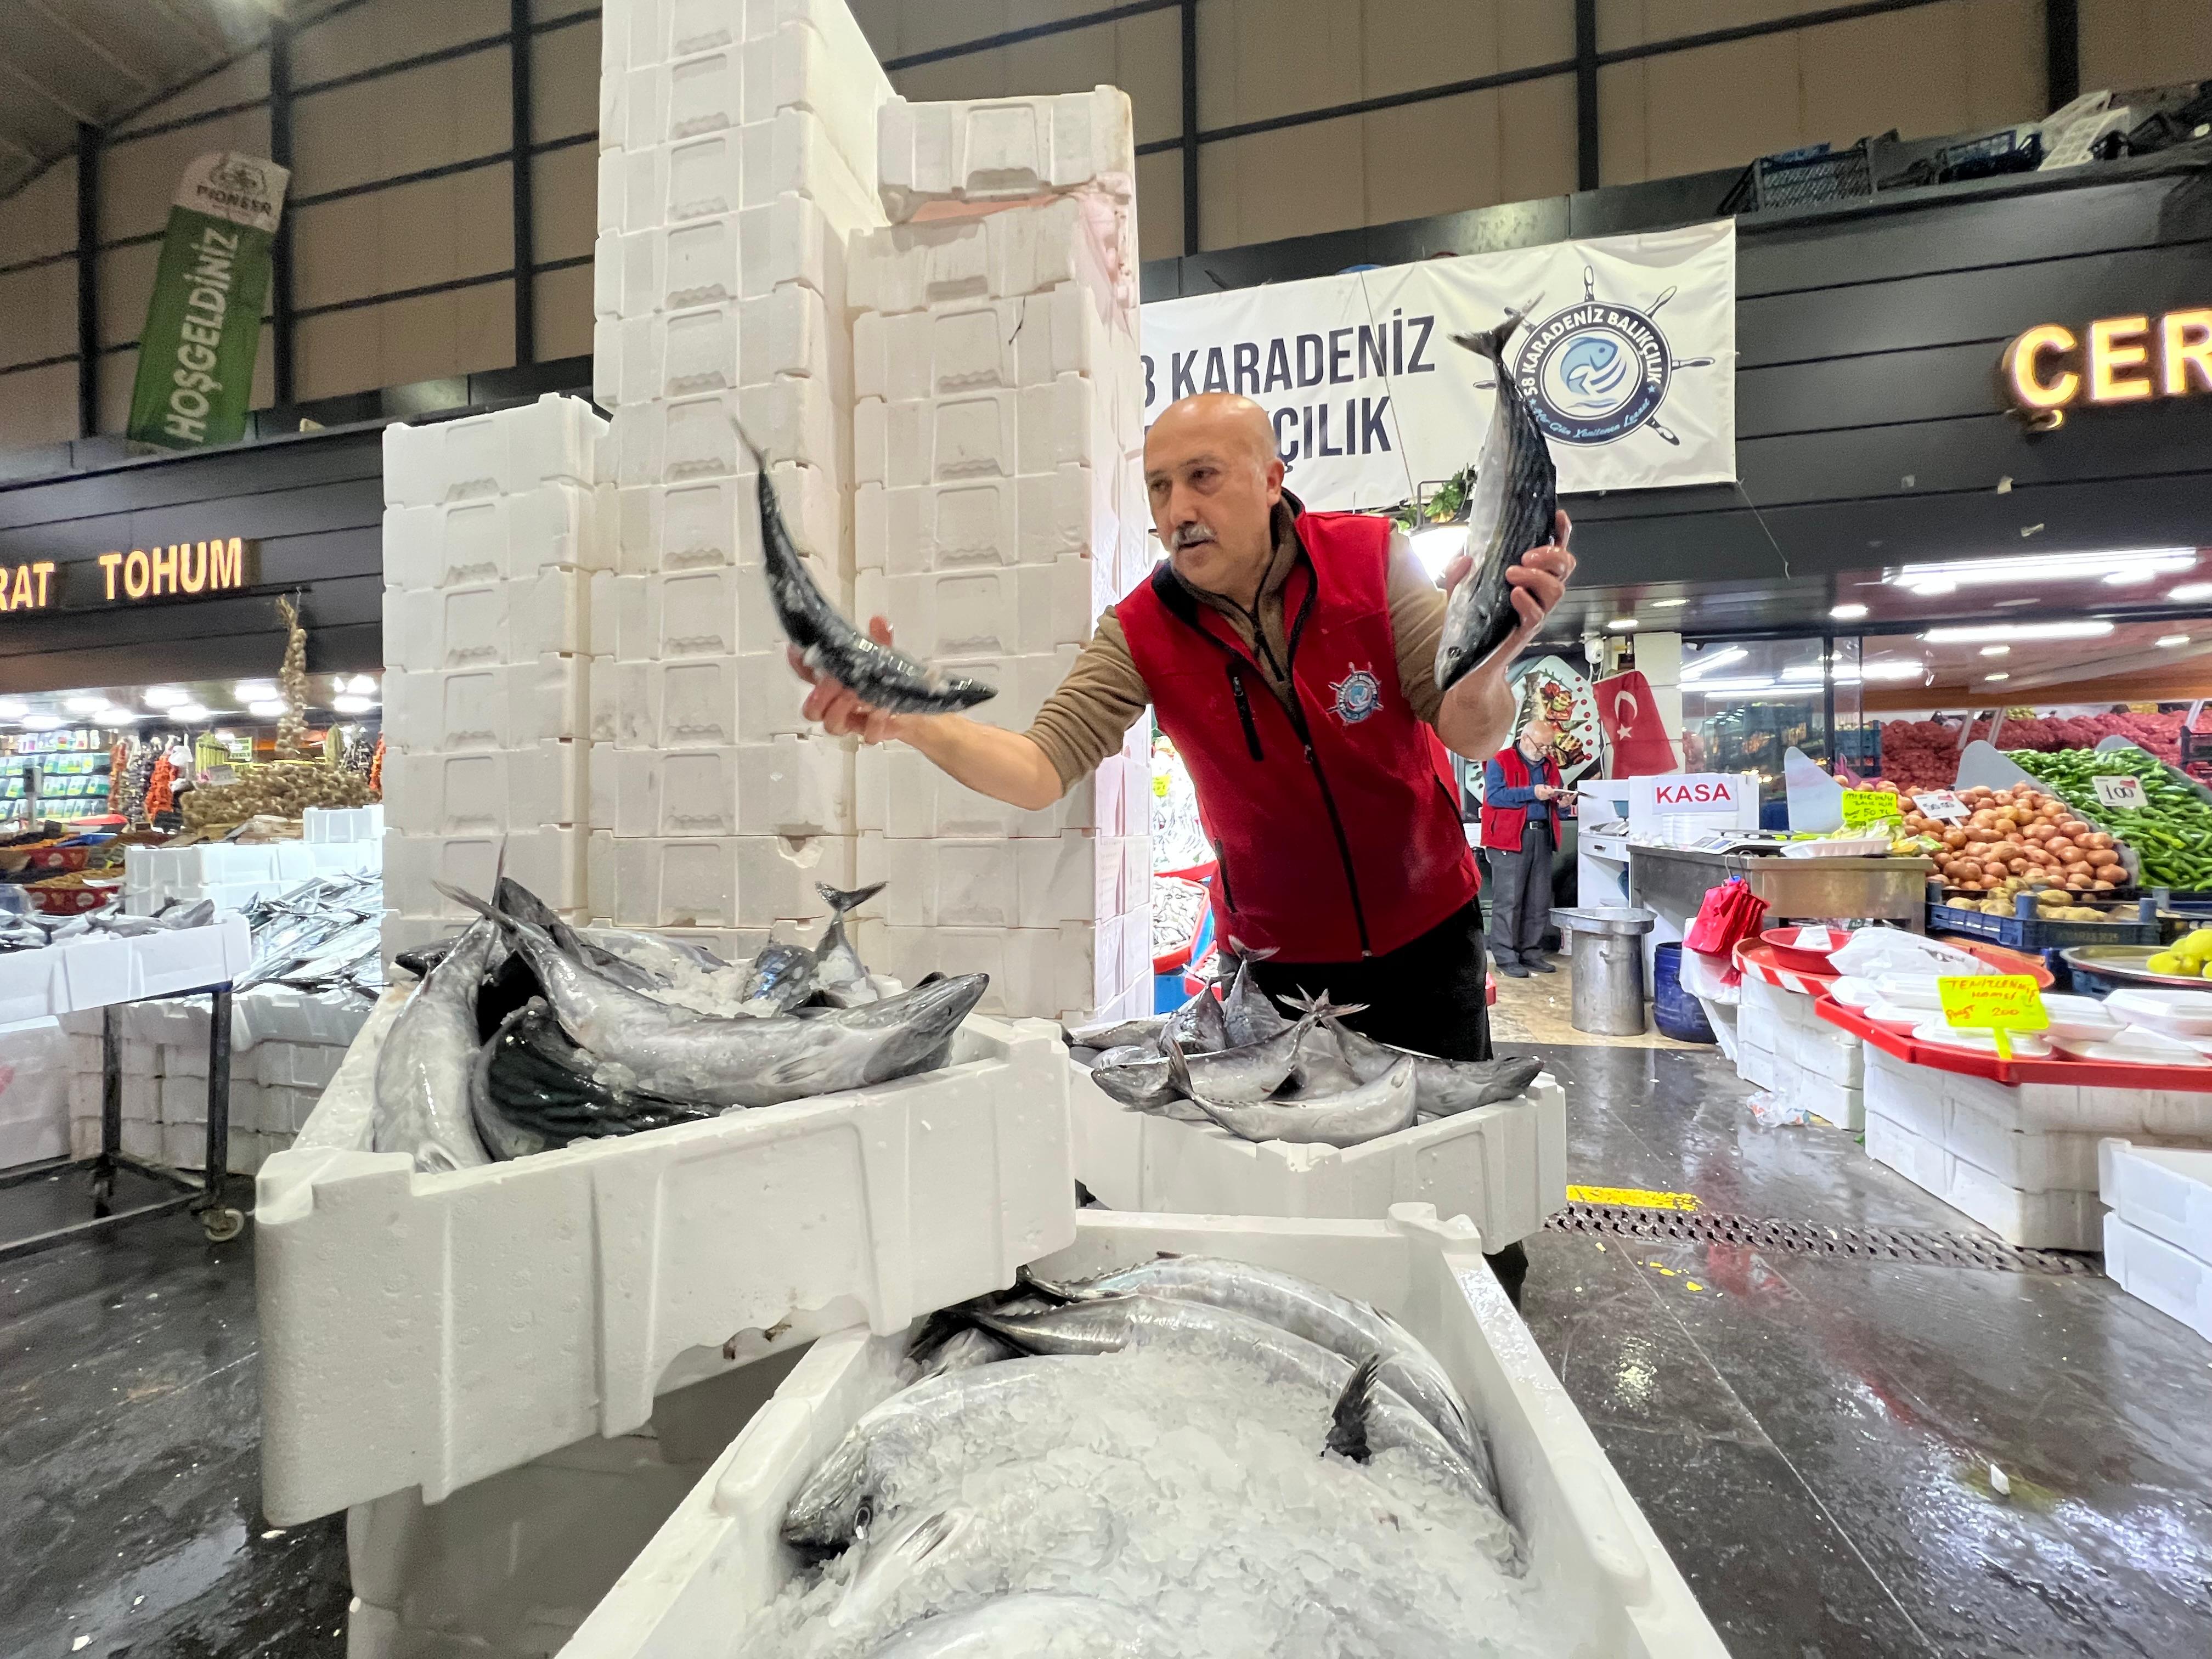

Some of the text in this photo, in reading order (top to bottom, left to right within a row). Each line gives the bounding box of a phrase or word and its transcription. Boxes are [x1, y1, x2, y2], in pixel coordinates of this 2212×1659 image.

[165, 226, 240, 444] HOŞGELDİNİZ
[1172, 307, 1435, 403] KARADENİZ
[1521, 306, 1604, 374] KARADENİZ
[1607, 311, 1663, 384] BALIKÇILIK
[99, 538, 242, 601] TOHUM
[1655, 782, 1731, 804] KASA
[1863, 808, 1876, 817] 50
[2106, 785, 2134, 800] 100
[1991, 1007, 2020, 1017] 200
